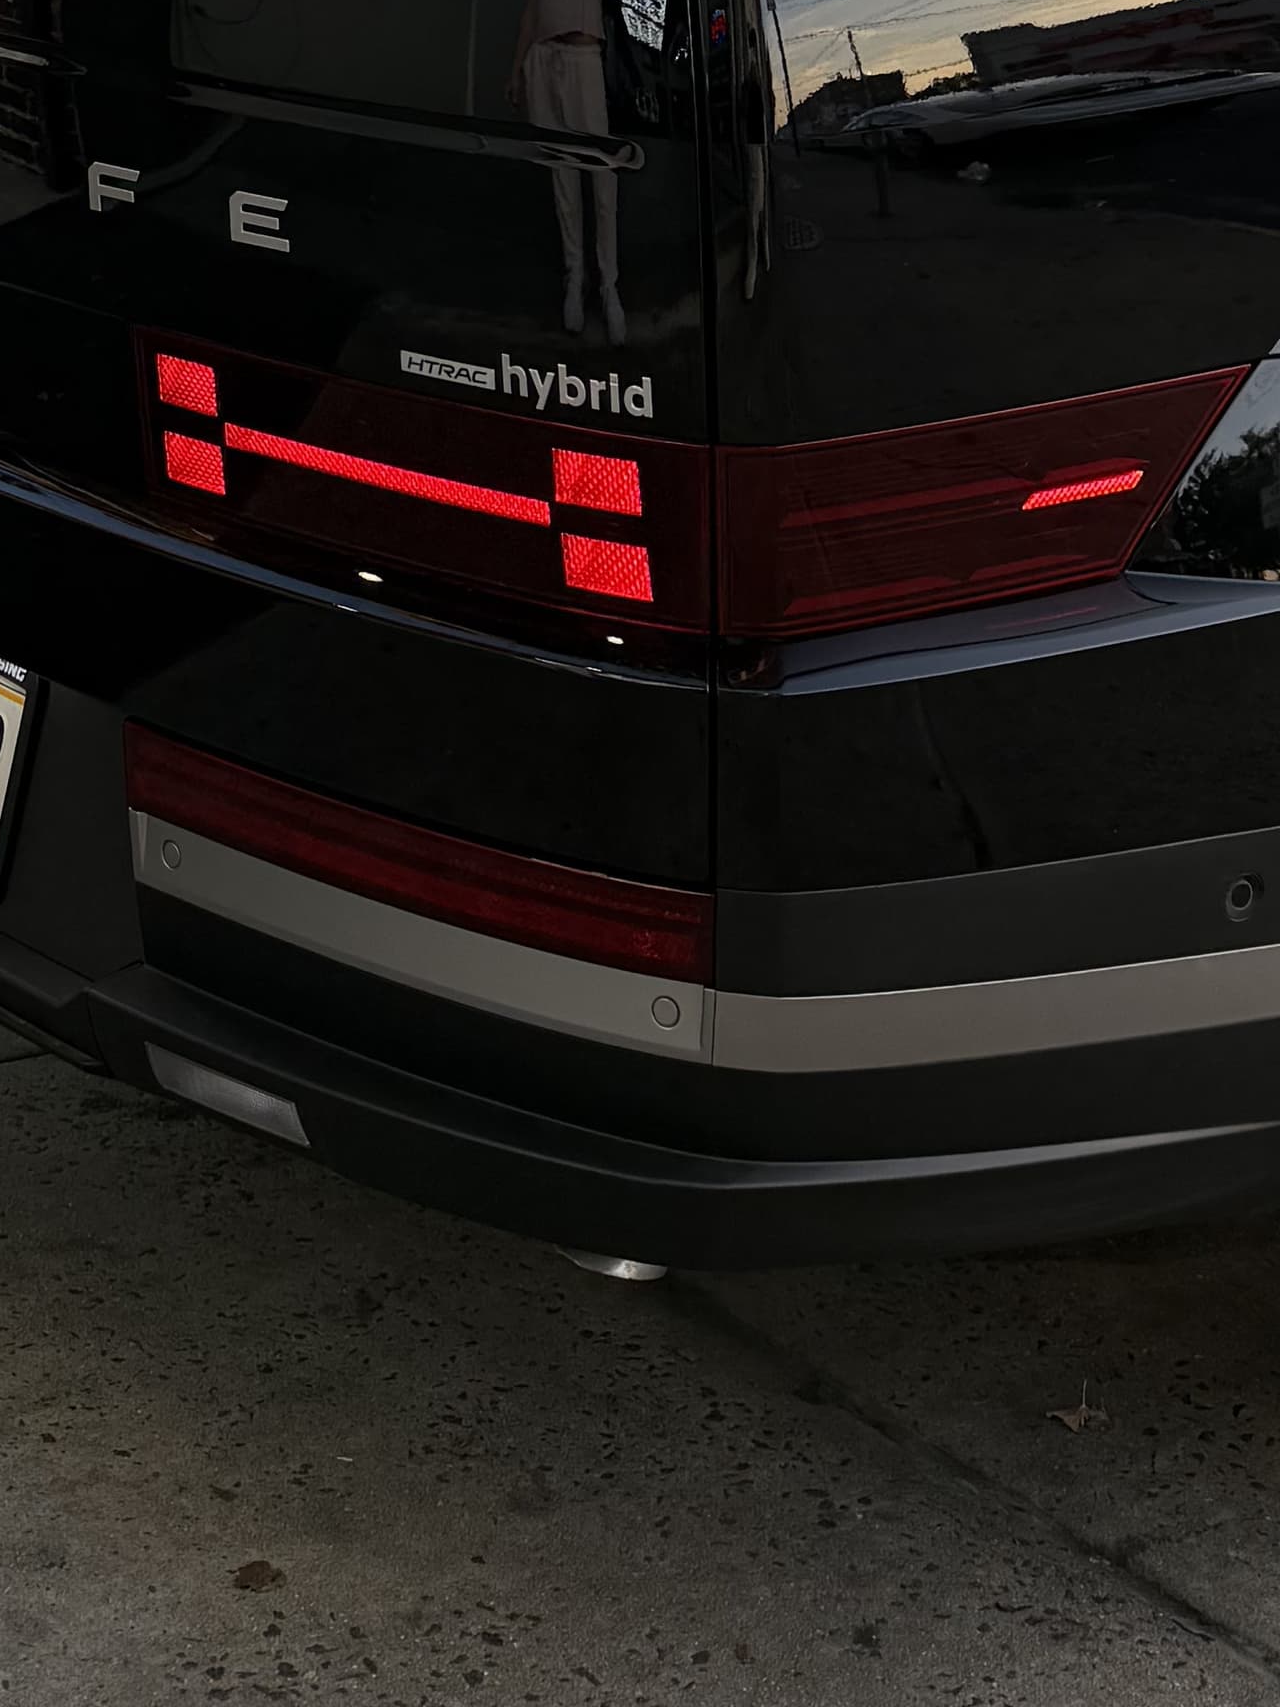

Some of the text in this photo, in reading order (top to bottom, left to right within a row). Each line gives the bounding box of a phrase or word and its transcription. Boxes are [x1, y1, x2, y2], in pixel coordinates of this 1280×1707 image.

[87, 160, 291, 254] FE
[406, 352, 654, 419] HTRAC hybrid
